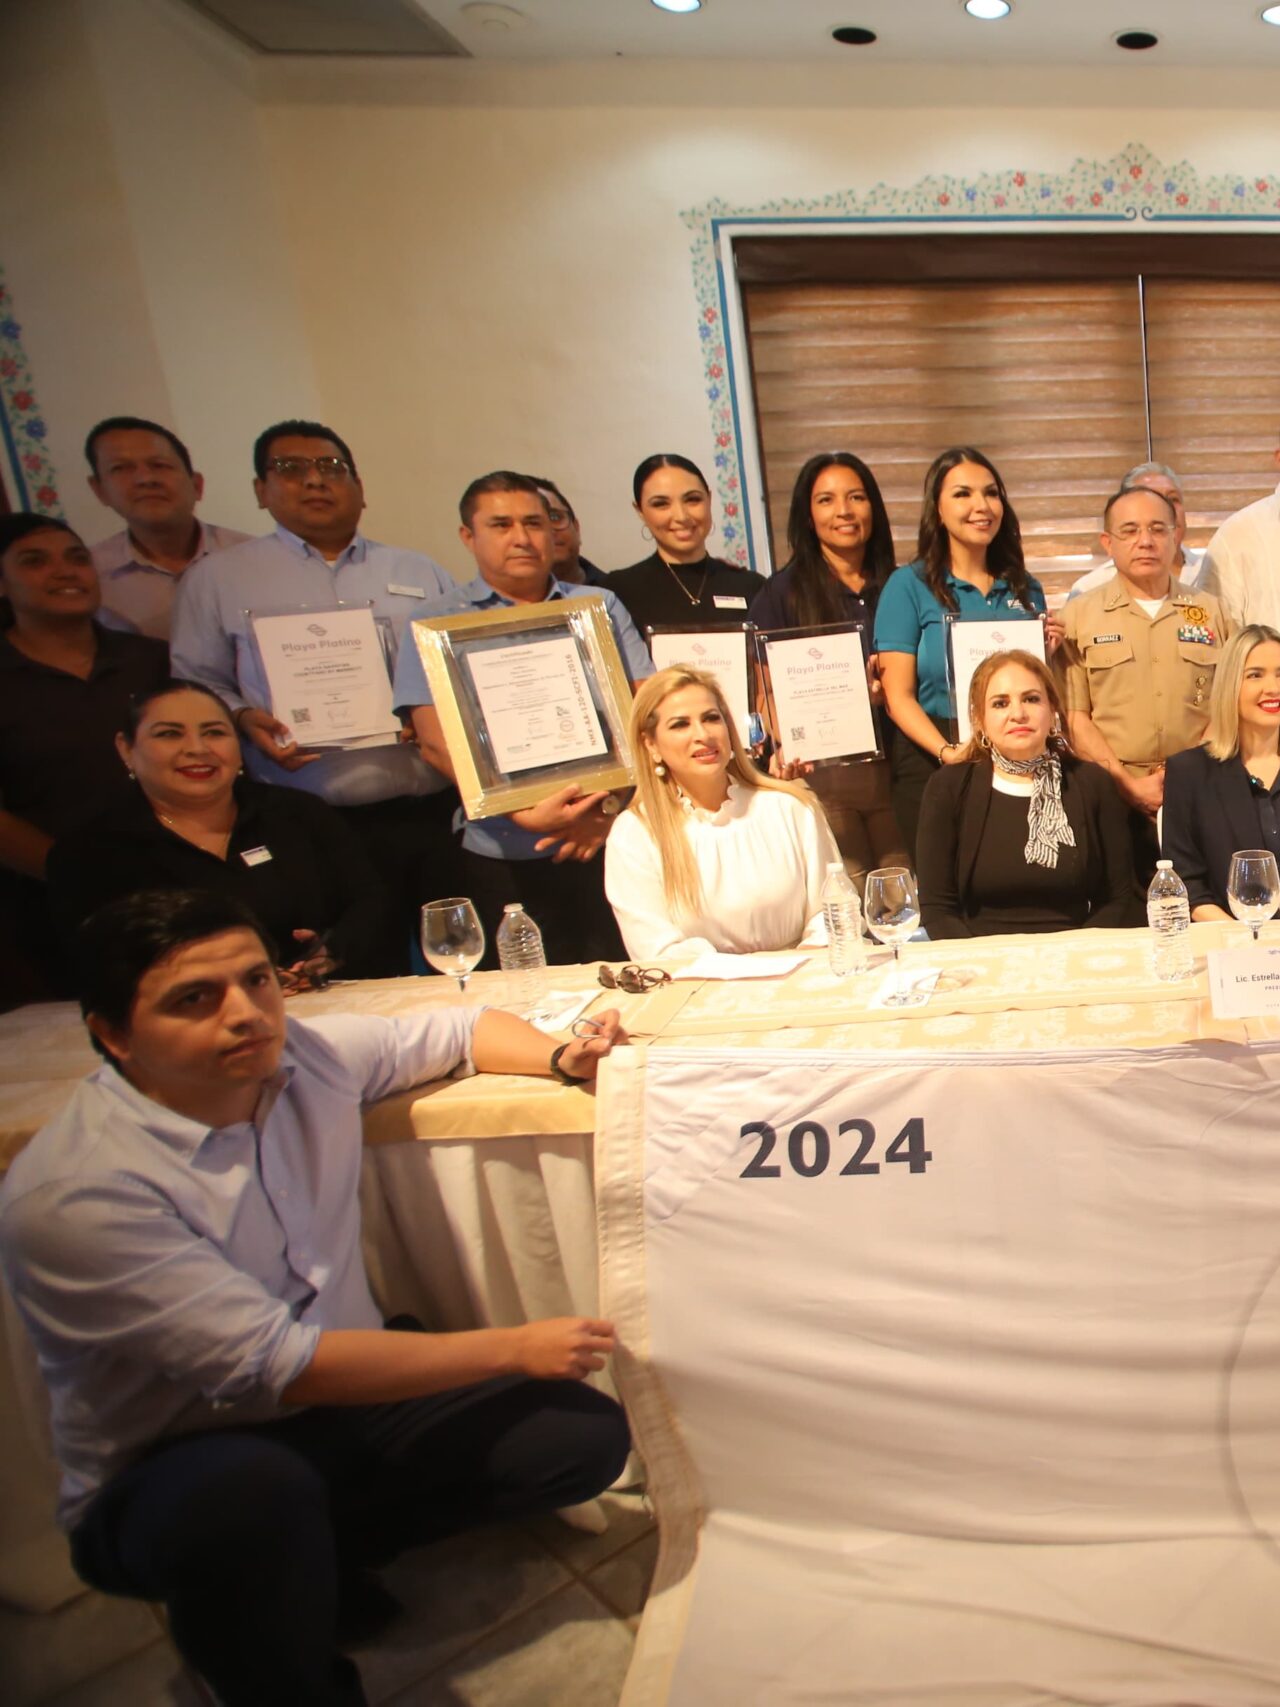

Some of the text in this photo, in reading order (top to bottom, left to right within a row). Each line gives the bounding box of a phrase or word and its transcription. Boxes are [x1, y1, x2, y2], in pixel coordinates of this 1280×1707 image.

[282, 639, 361, 652] Playa Platino
[787, 661, 850, 676] Playa Platino
[1236, 974, 1248, 983] Lic.
[1251, 972, 1280, 982] Estrella
[739, 1117, 932, 1178] 2024
